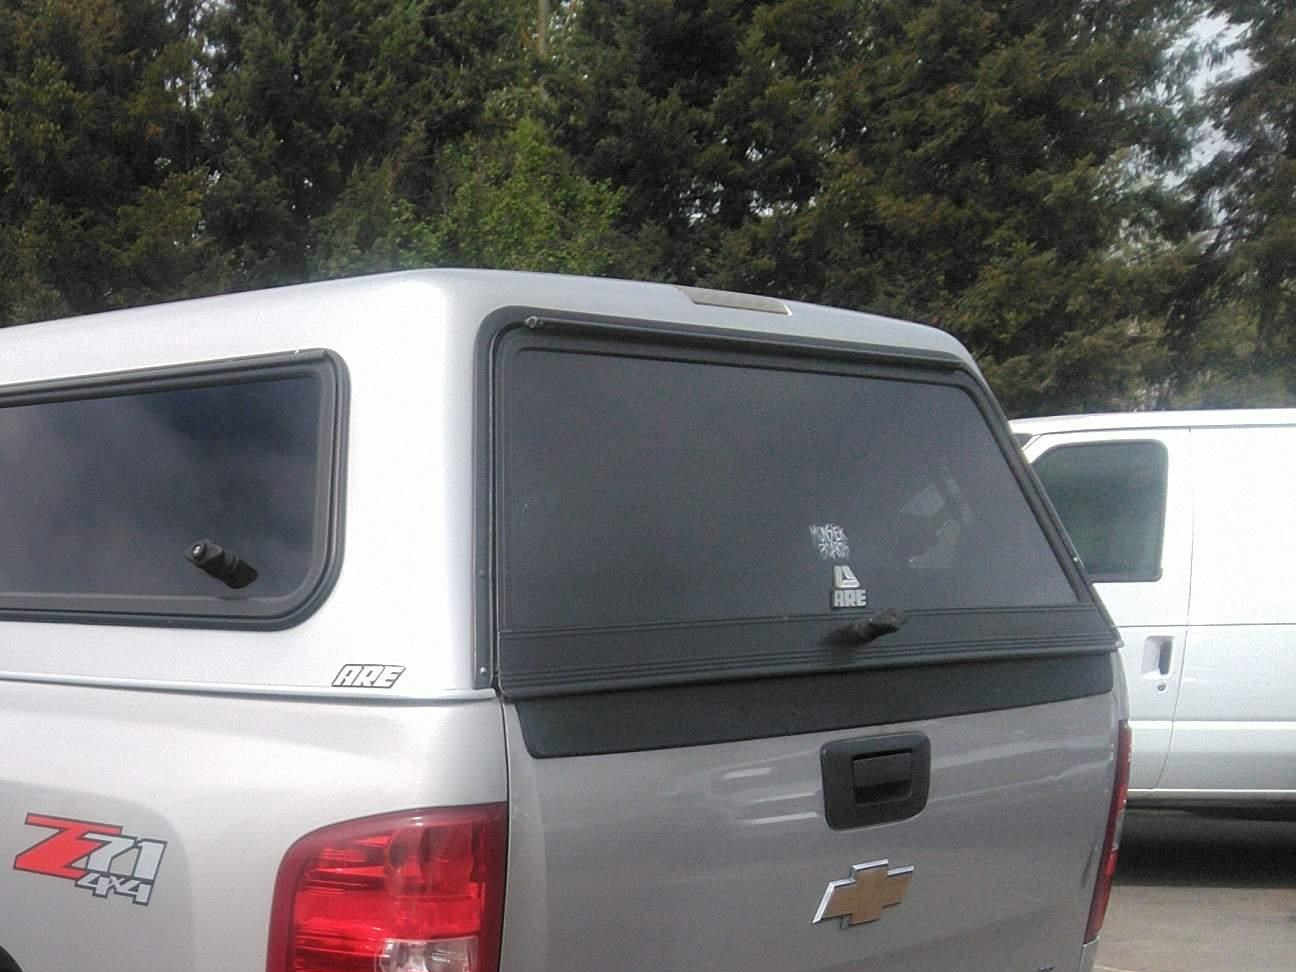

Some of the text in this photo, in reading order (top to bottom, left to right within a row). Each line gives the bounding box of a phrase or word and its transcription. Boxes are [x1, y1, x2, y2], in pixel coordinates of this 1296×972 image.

[833, 589, 867, 607] ARE
[331, 663, 406, 689] ARE
[13, 812, 168, 884] Z71
